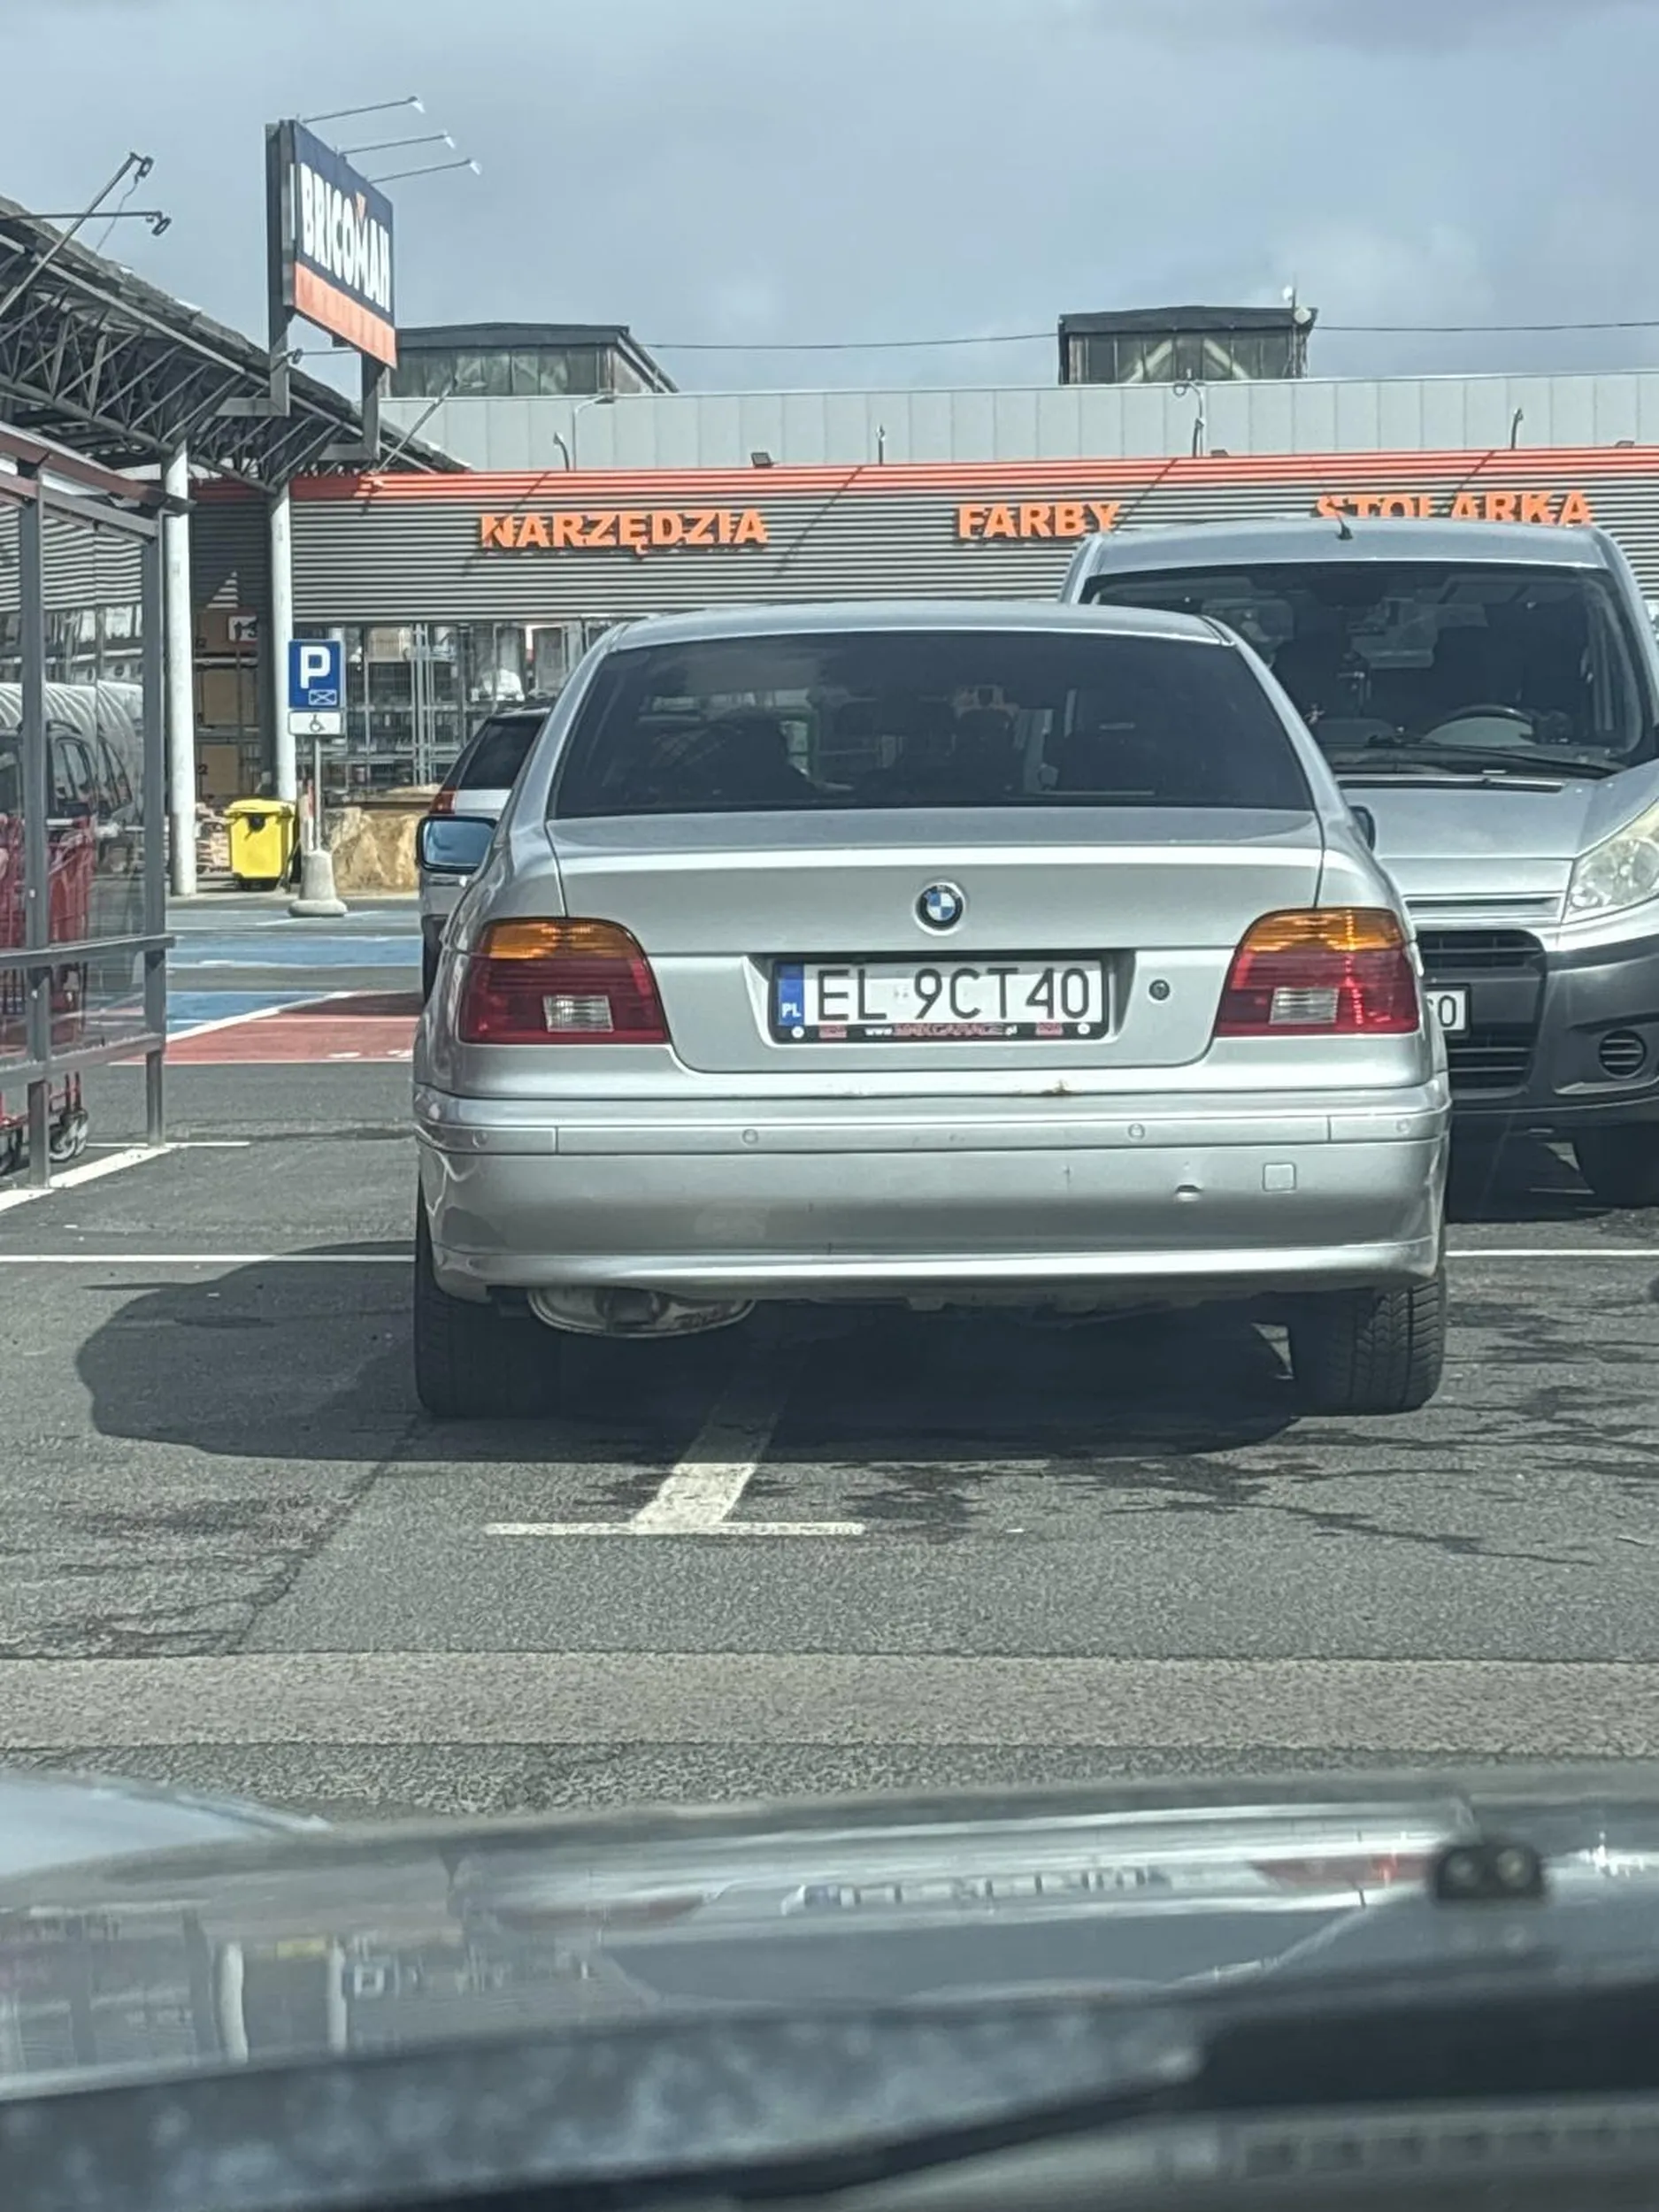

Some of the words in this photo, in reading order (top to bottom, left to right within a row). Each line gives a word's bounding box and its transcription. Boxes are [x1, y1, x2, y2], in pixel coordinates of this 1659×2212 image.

[300, 162, 391, 312] BRICOMAN
[480, 510, 768, 555] NARZĘDZIA
[958, 503, 1121, 539] FARBY
[300, 646, 331, 689] P
[782, 1002, 802, 1018] PL
[818, 969, 887, 1021] EL
[914, 967, 1090, 1020] 9CT40
